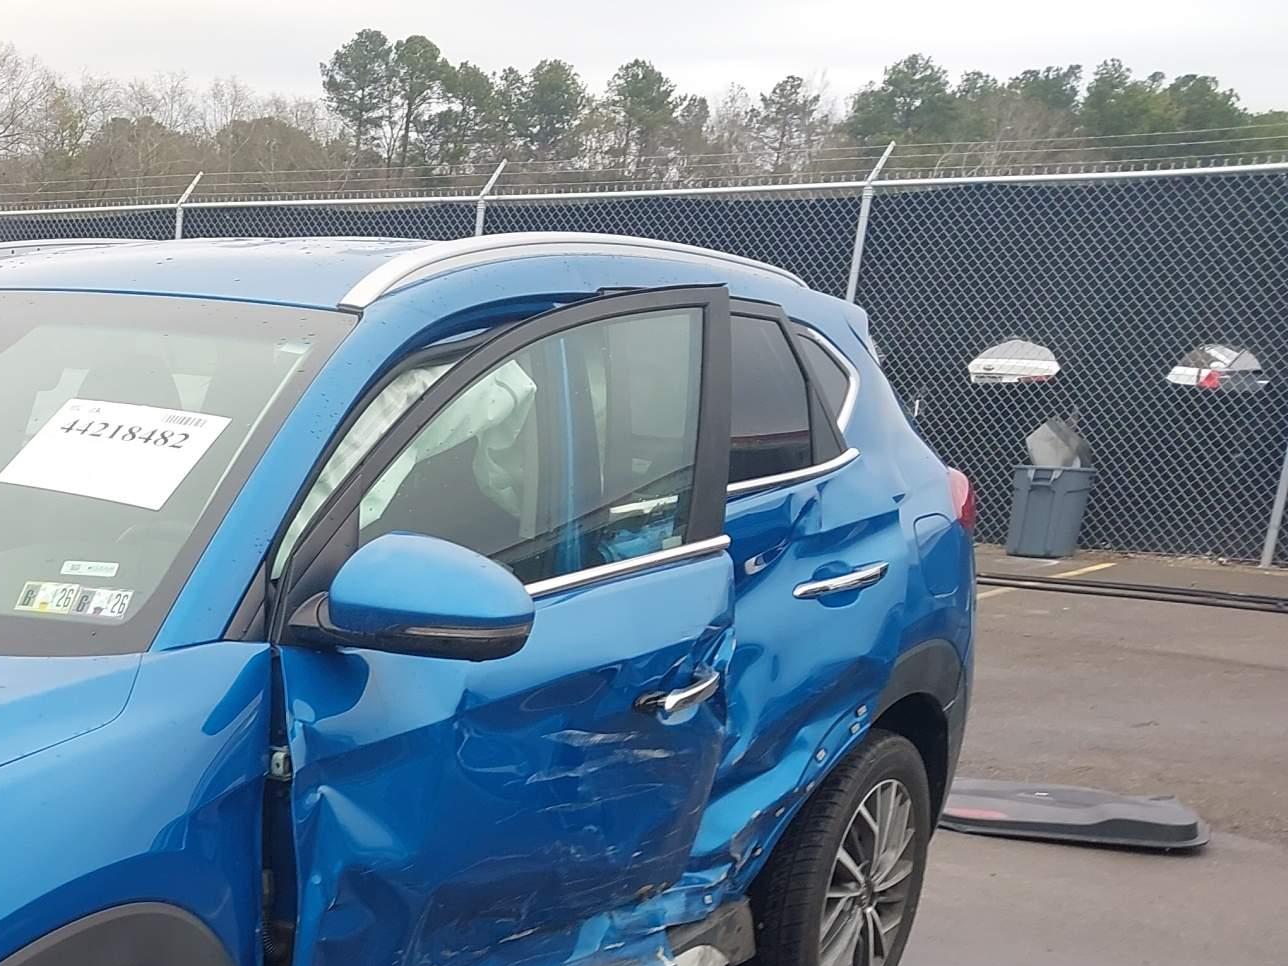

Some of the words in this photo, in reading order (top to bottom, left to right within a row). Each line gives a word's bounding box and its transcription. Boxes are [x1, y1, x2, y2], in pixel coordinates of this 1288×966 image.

[60, 418, 190, 449] 44218482
[55, 587, 75, 608] 26
[109, 592, 129, 615] 26
